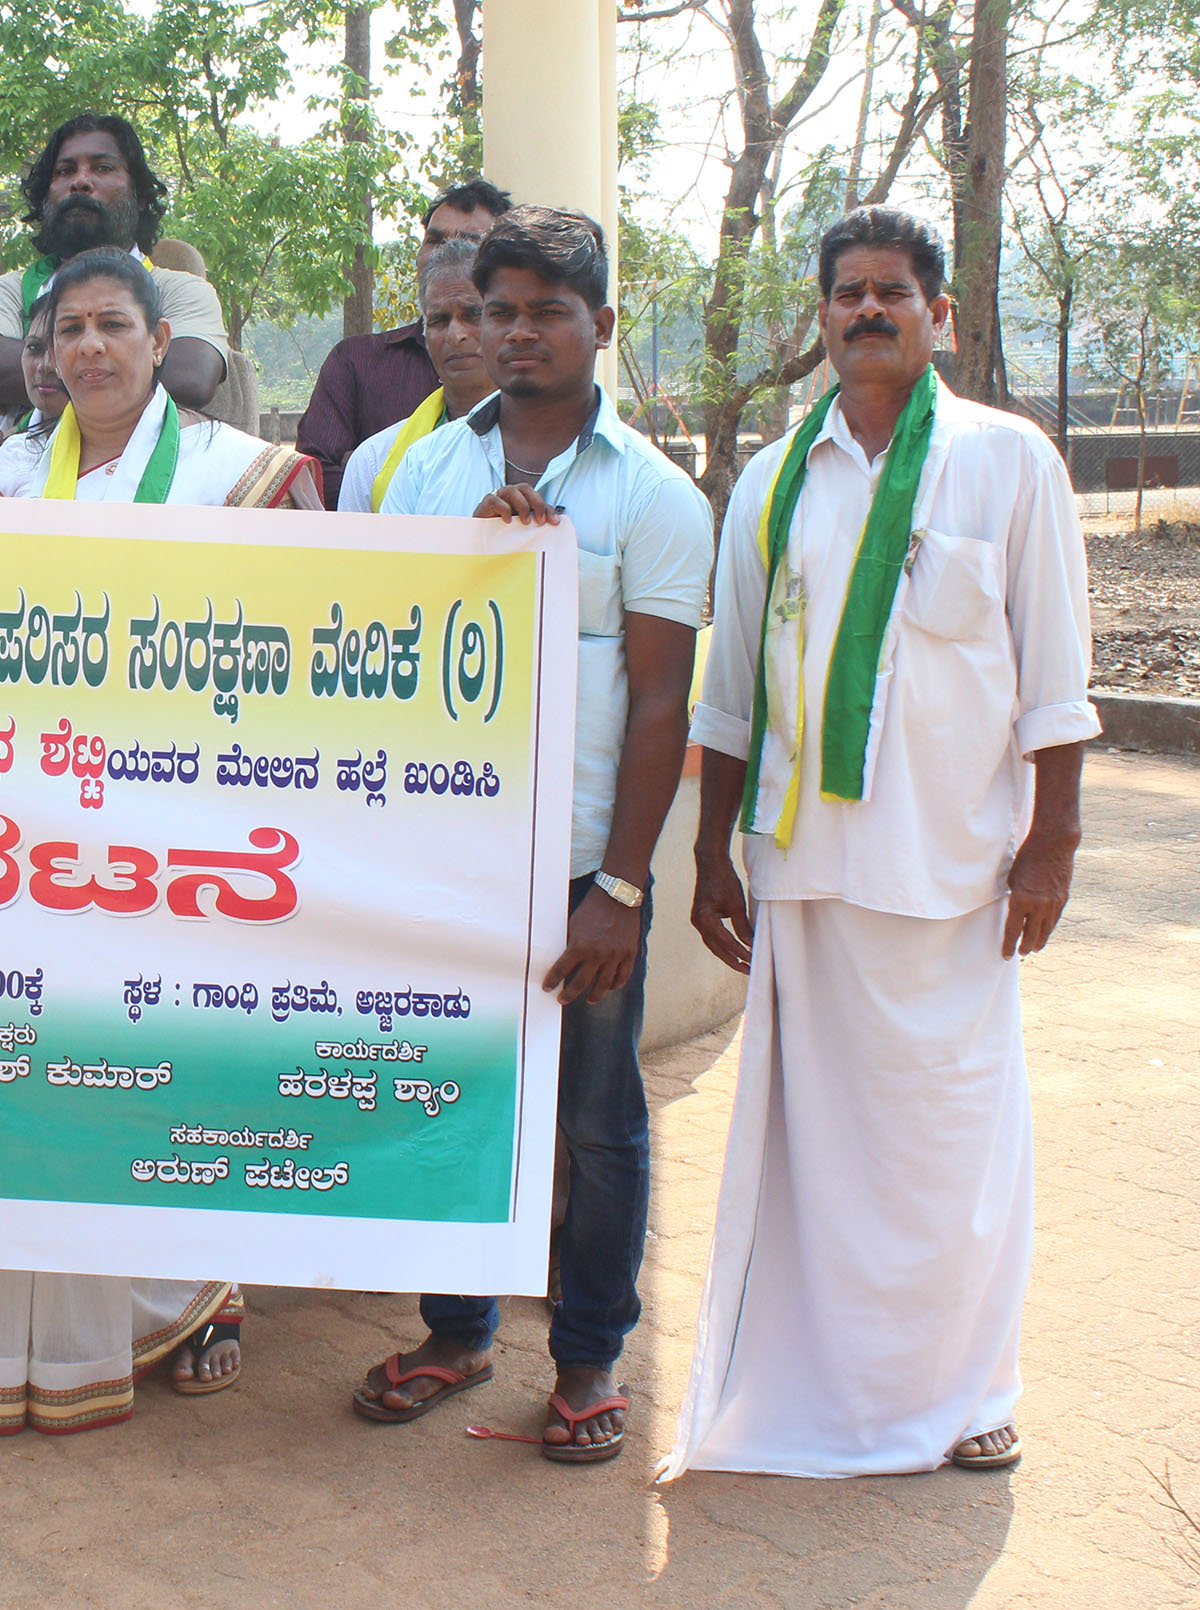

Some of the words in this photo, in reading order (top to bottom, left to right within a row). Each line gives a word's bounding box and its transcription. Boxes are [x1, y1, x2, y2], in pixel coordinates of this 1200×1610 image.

[129, 594, 290, 722] ಸಂರಕ್ಷಣಾ
[311, 602, 422, 700] ವೇದಿಕೆ
[443, 599, 503, 722] (ರಿ)
[40, 718, 199, 809] ಶೆಟ್ಟಿಯವರ
[216, 743, 319, 790] ಮೇಲಿನ
[337, 748, 387, 807] ಹಲ್ಲೆ
[404, 759, 500, 797] ಖಂಡಿಸಿ
[123, 972, 162, 1023] ಸ್ಥಳ
[193, 980, 259, 1014] ಗಾಂಧಿ
[271, 979, 343, 1022] ಪ್ರತಿಮೆ,
[356, 984, 471, 1032] ಅಜ್ಜರಕಾಡು
[315, 1038, 427, 1062] ಕಾರ್ಯದರ್ಶಿ
[46, 1056, 172, 1089] ಕುಮಾರ್
[277, 1066, 378, 1110] ಹರಳಪ್ಪ
[393, 1077, 461, 1118] ಶ್ಯಾಂ
[170, 1123, 313, 1150] ಸಹಕಾರ್ಯದರ್ಶಿ
[131, 1153, 229, 1184] ಅರುಣ್
[244, 1157, 349, 1190] ಪಟೇಲ್
